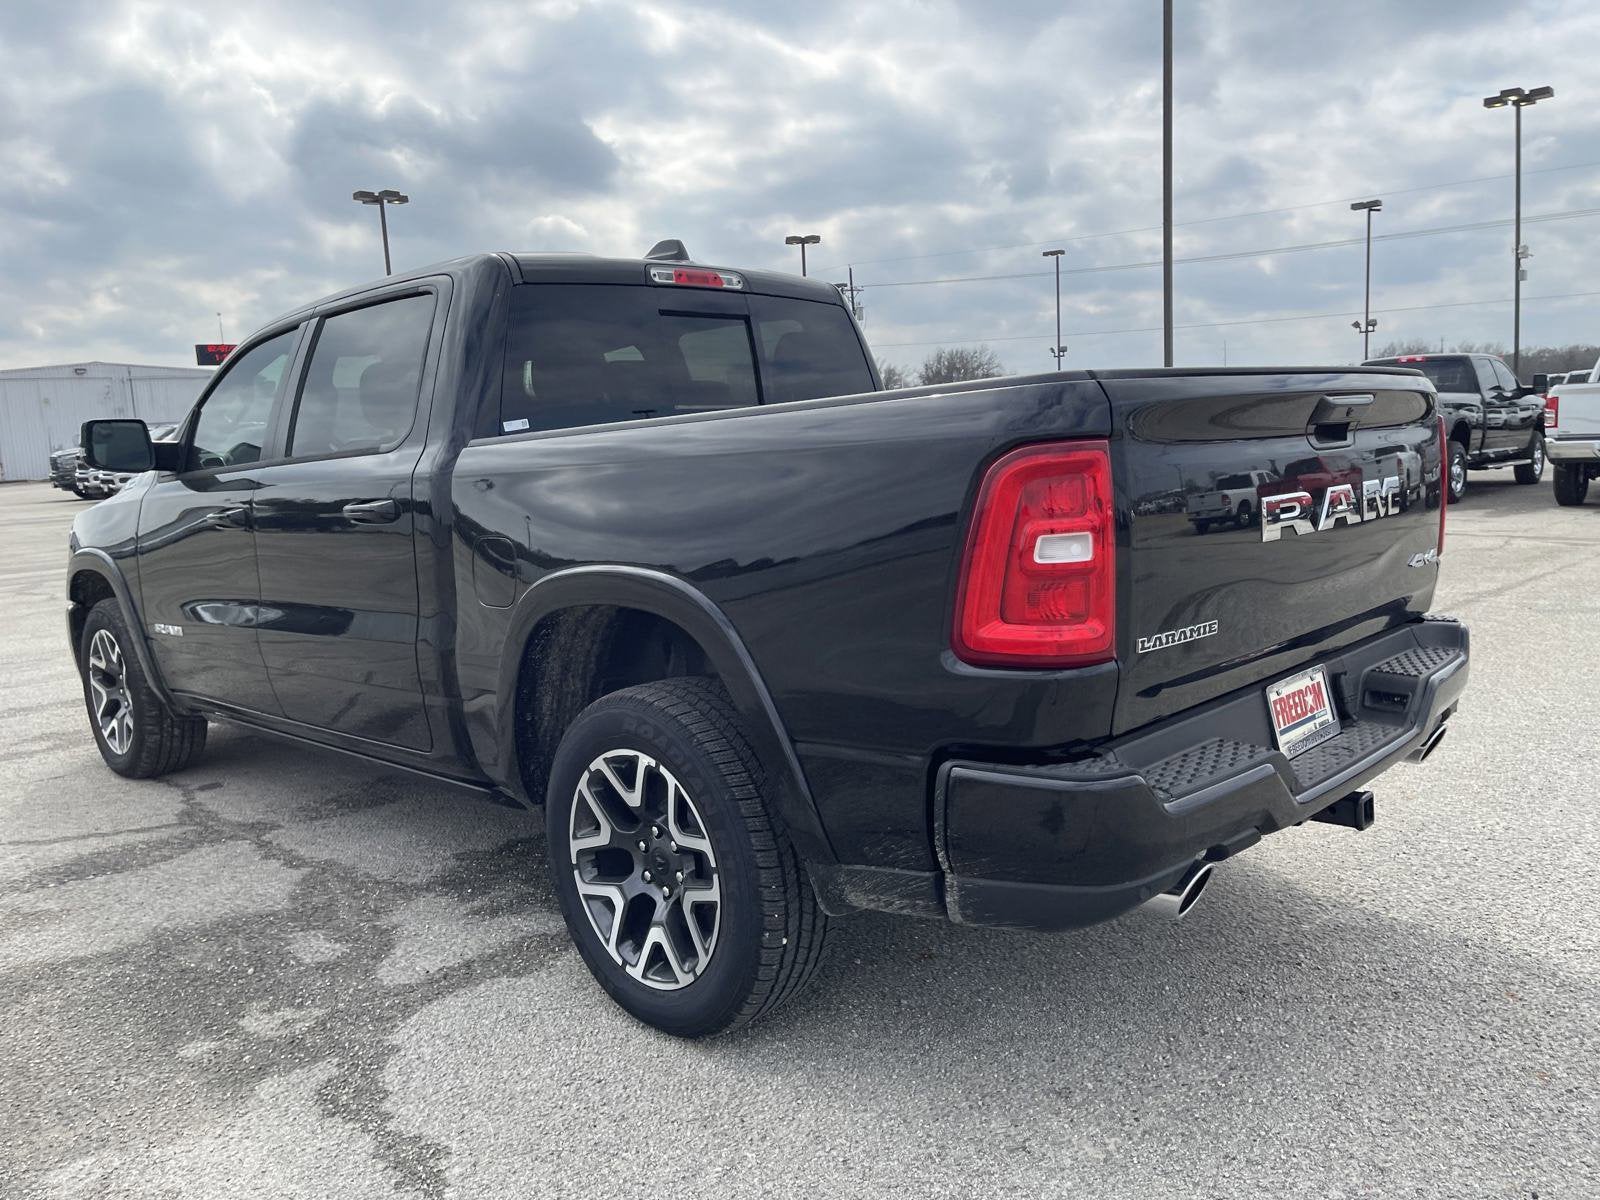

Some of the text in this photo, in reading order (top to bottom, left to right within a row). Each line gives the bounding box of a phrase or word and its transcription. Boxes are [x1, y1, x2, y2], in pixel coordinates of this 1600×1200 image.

[1262, 476, 1399, 542] RAM
[1138, 620, 1218, 653] LARAMIE
[1272, 681, 1325, 729] FREEDOM
